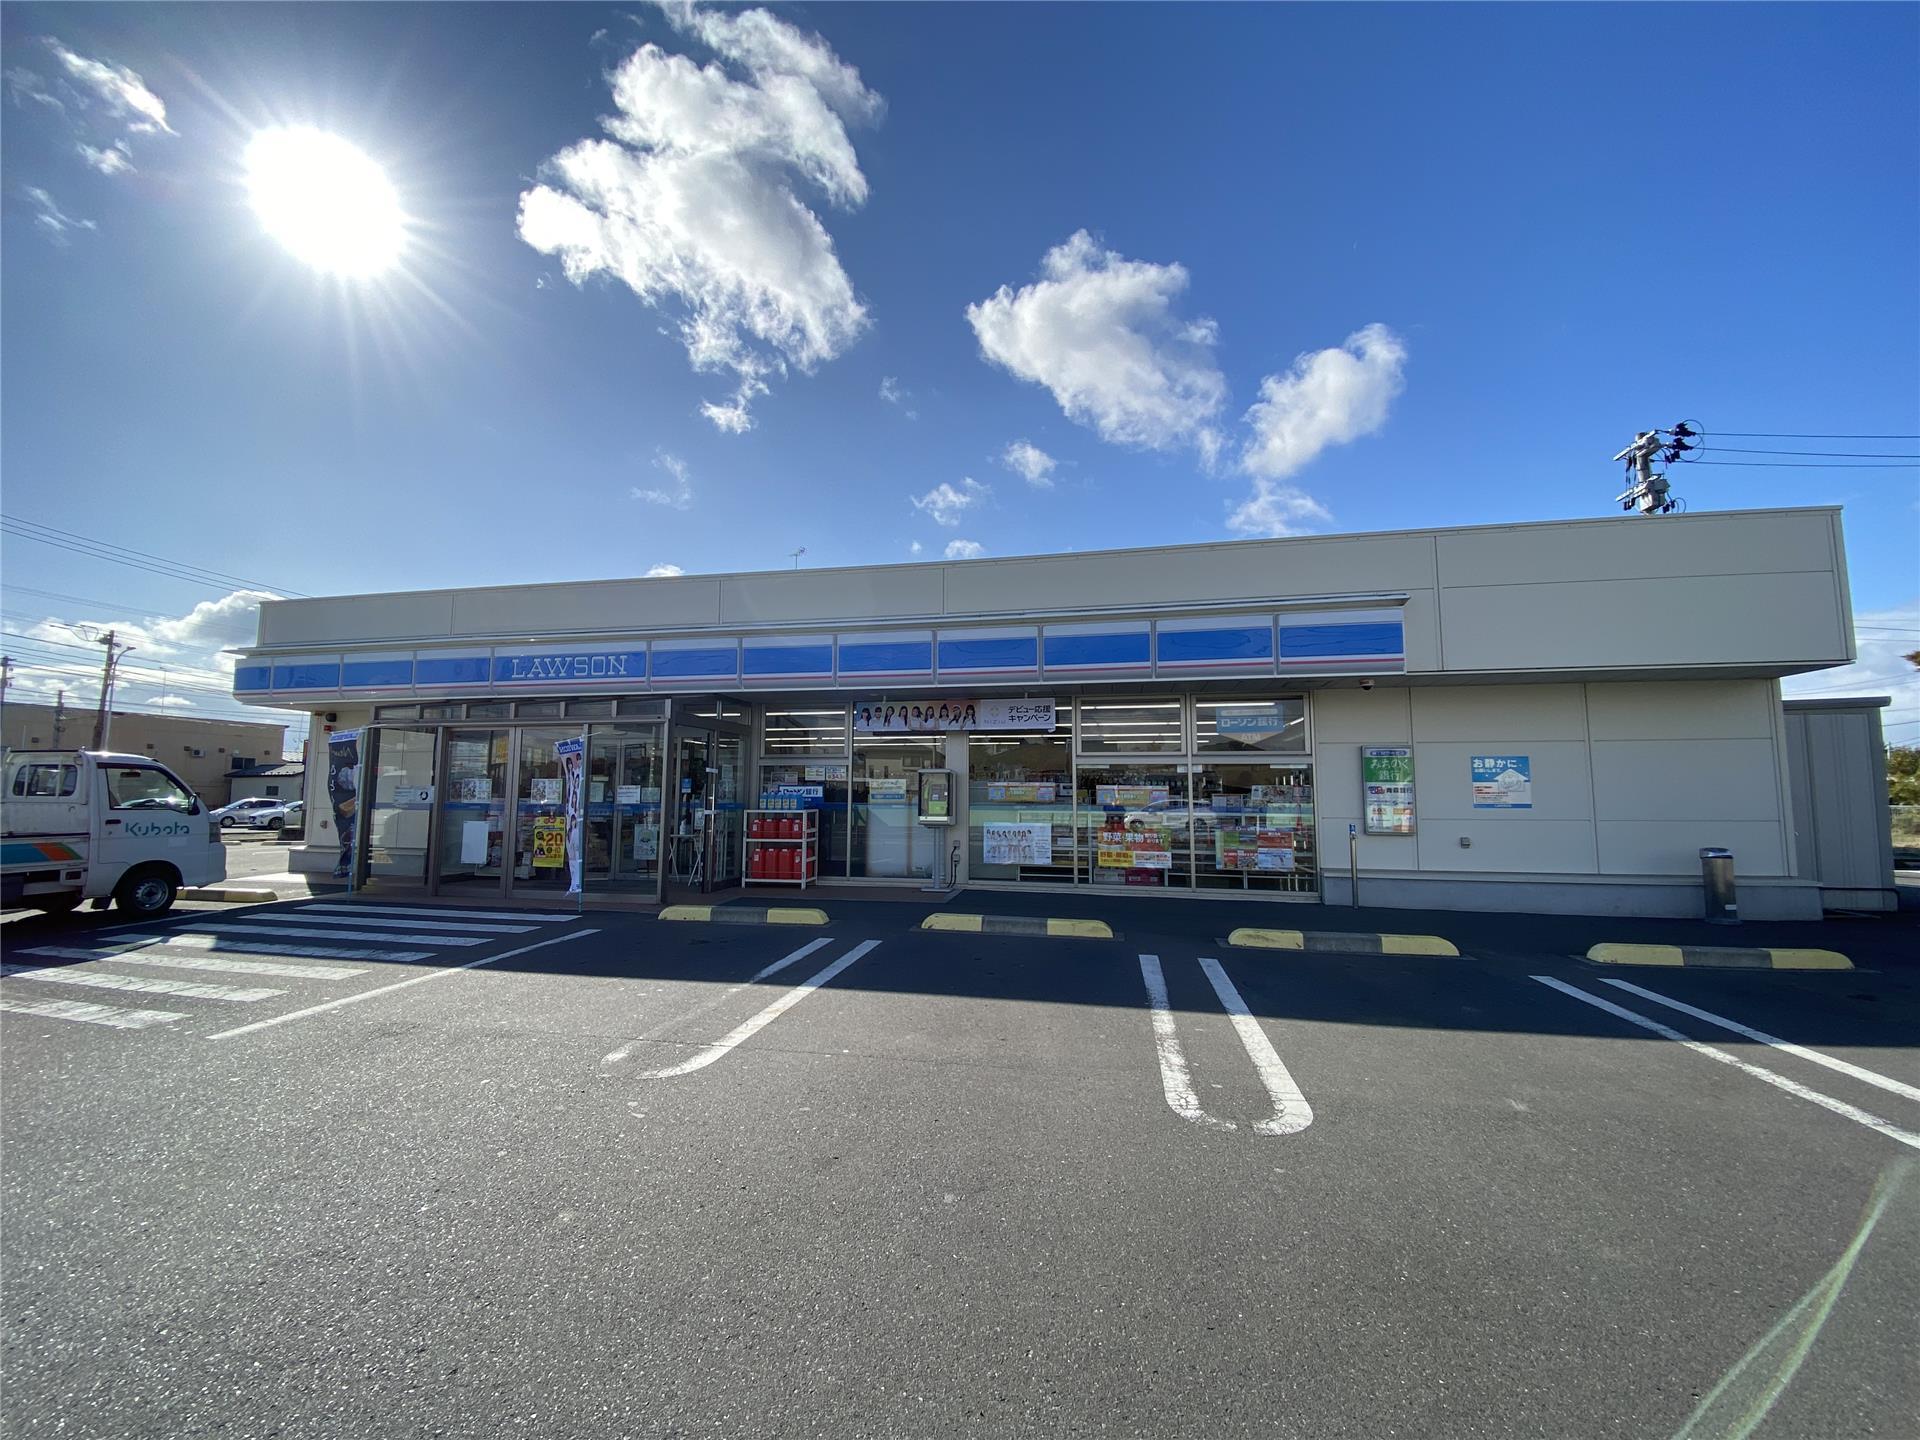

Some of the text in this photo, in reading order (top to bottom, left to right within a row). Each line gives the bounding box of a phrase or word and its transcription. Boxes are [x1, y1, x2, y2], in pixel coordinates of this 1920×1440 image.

[511, 655, 628, 678] LAWSON
[1008, 705, 1051, 714] デビュー応援
[1009, 714, 1051, 722] キャンペーン
[1221, 718, 1278, 727] ローソン銀行
[1371, 759, 1408, 769] みちのく
[1472, 759, 1517, 768] お静かに
[1379, 770, 1401, 781] 銀行
[125, 821, 190, 836] Kubota
